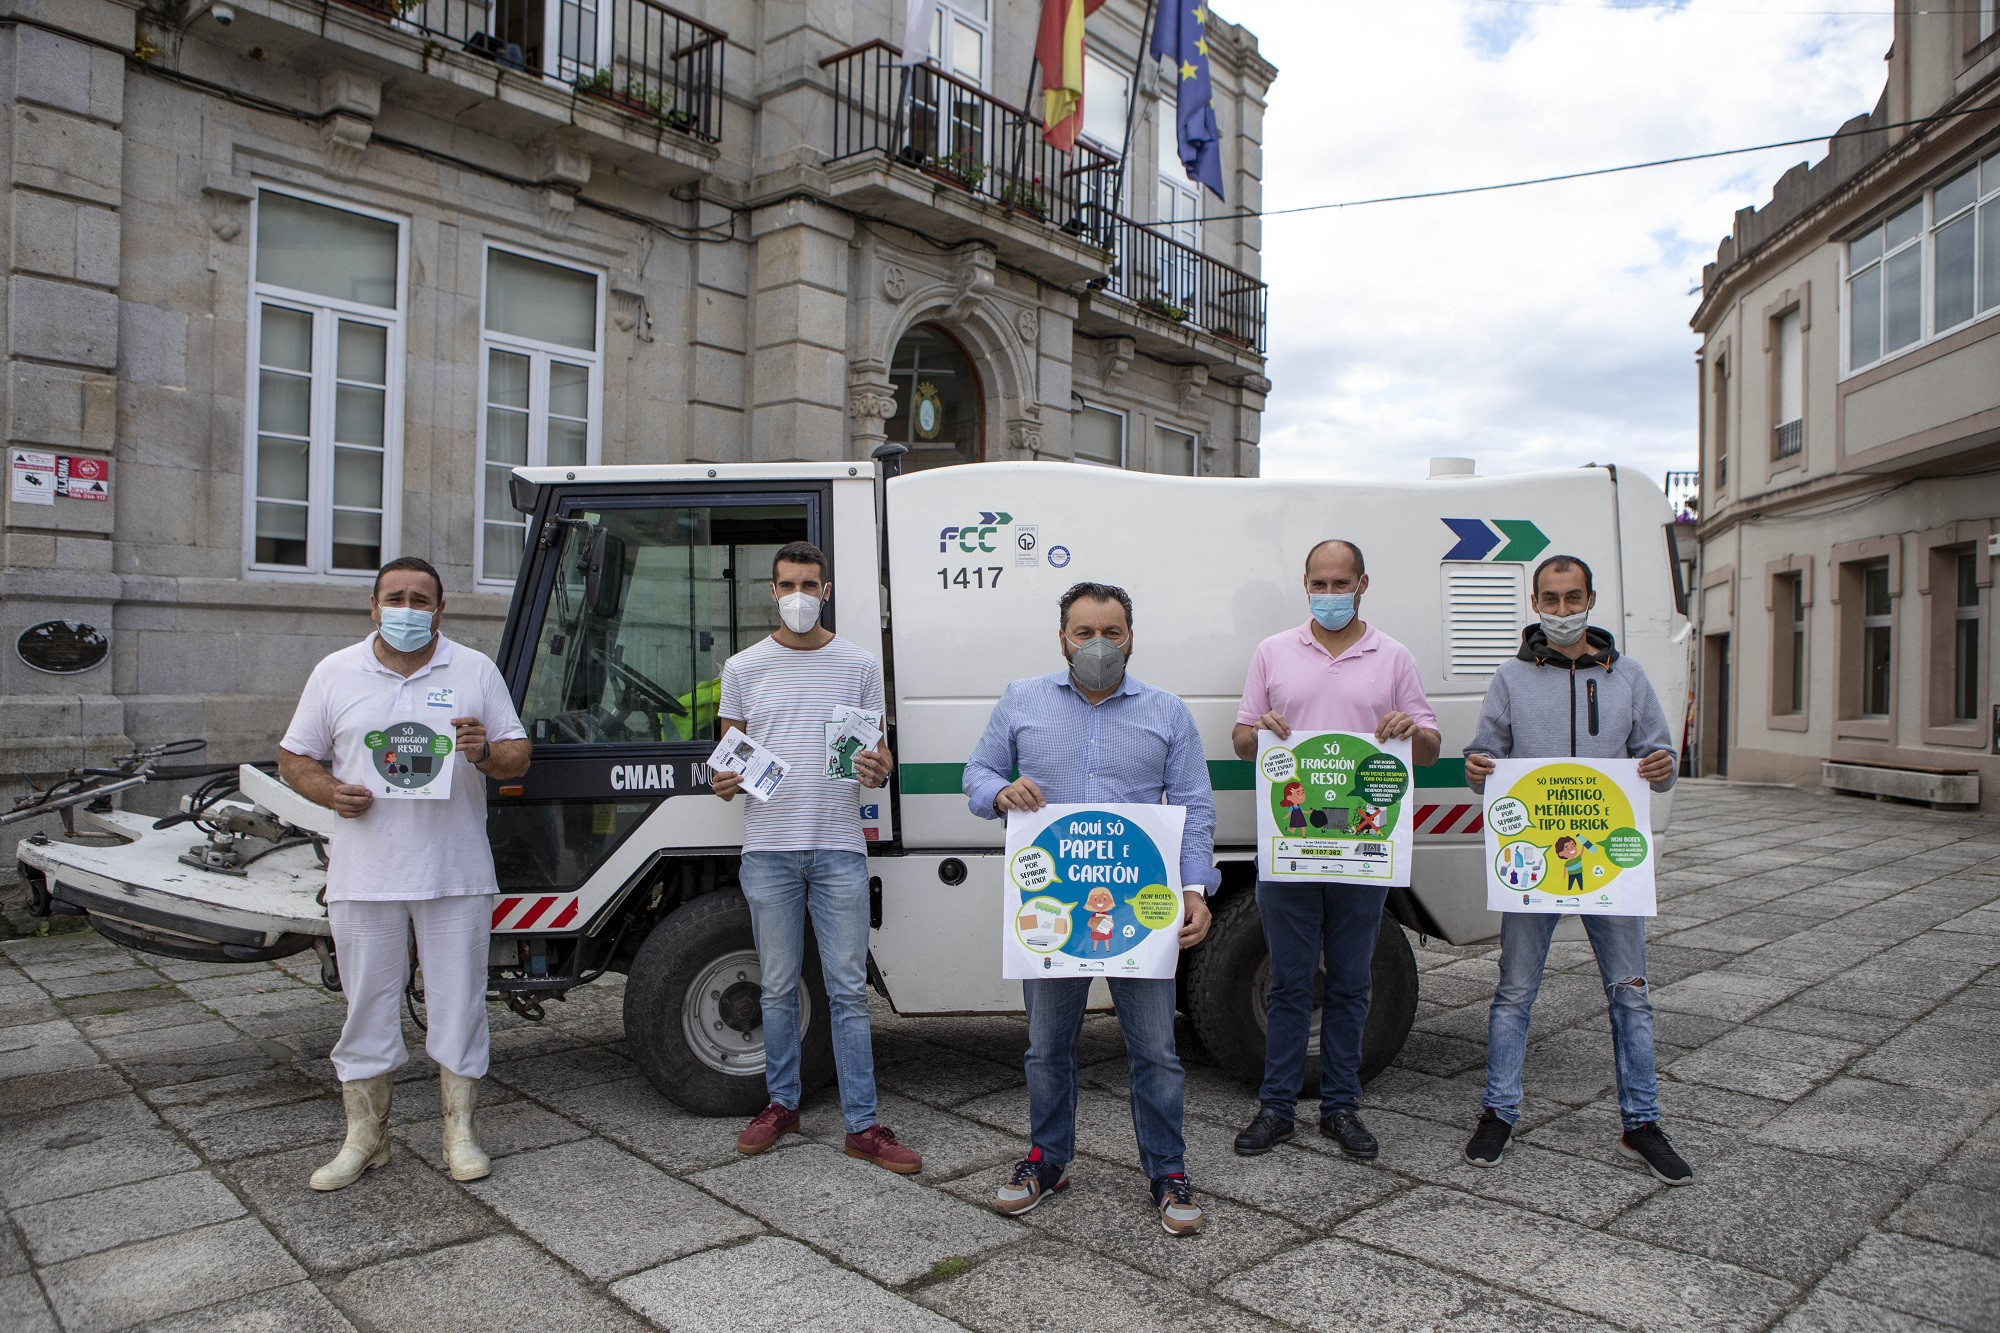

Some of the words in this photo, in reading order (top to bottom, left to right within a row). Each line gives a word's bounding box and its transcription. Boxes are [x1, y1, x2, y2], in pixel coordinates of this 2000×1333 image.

[58, 459, 69, 494] ALARMA
[940, 526, 997, 553] FCC
[937, 567, 1003, 590] 1417
[428, 692, 448, 702] FCC
[390, 735, 428, 744] FRACCIÓN
[397, 745, 423, 754] RESTO
[1323, 741, 1340, 756] SÓ
[1300, 757, 1355, 770] FRACCIÓN
[610, 764, 675, 790] CMAR
[1310, 772, 1347, 786] RESTO
[1536, 777, 1547, 786] SÓ
[1550, 777, 1583, 786] ENVASES
[1586, 777, 1597, 785] DE
[1547, 787, 1605, 802] PLÁSTICO,
[1495, 801, 1516, 812] GRAZAS
[1535, 802, 1600, 816] METÁLICOS
[1605, 807, 1609, 816] E
[1497, 815, 1522, 826] SEPARAR
[1501, 810, 1514, 818] POR
[1069, 820, 1101, 836] AQUÍ
[1106, 819, 1124, 836] SÓ
[1538, 819, 1565, 831] TIPO
[1570, 819, 1609, 831] BRICK
[1059, 839, 1114, 859] PAPEL
[1123, 845, 1129, 858] E
[1018, 852, 1041, 863] GRAZAS
[1025, 861, 1038, 870] POR
[1020, 867, 1047, 880] SEPARAR
[1068, 862, 1139, 884] CARTÓN
